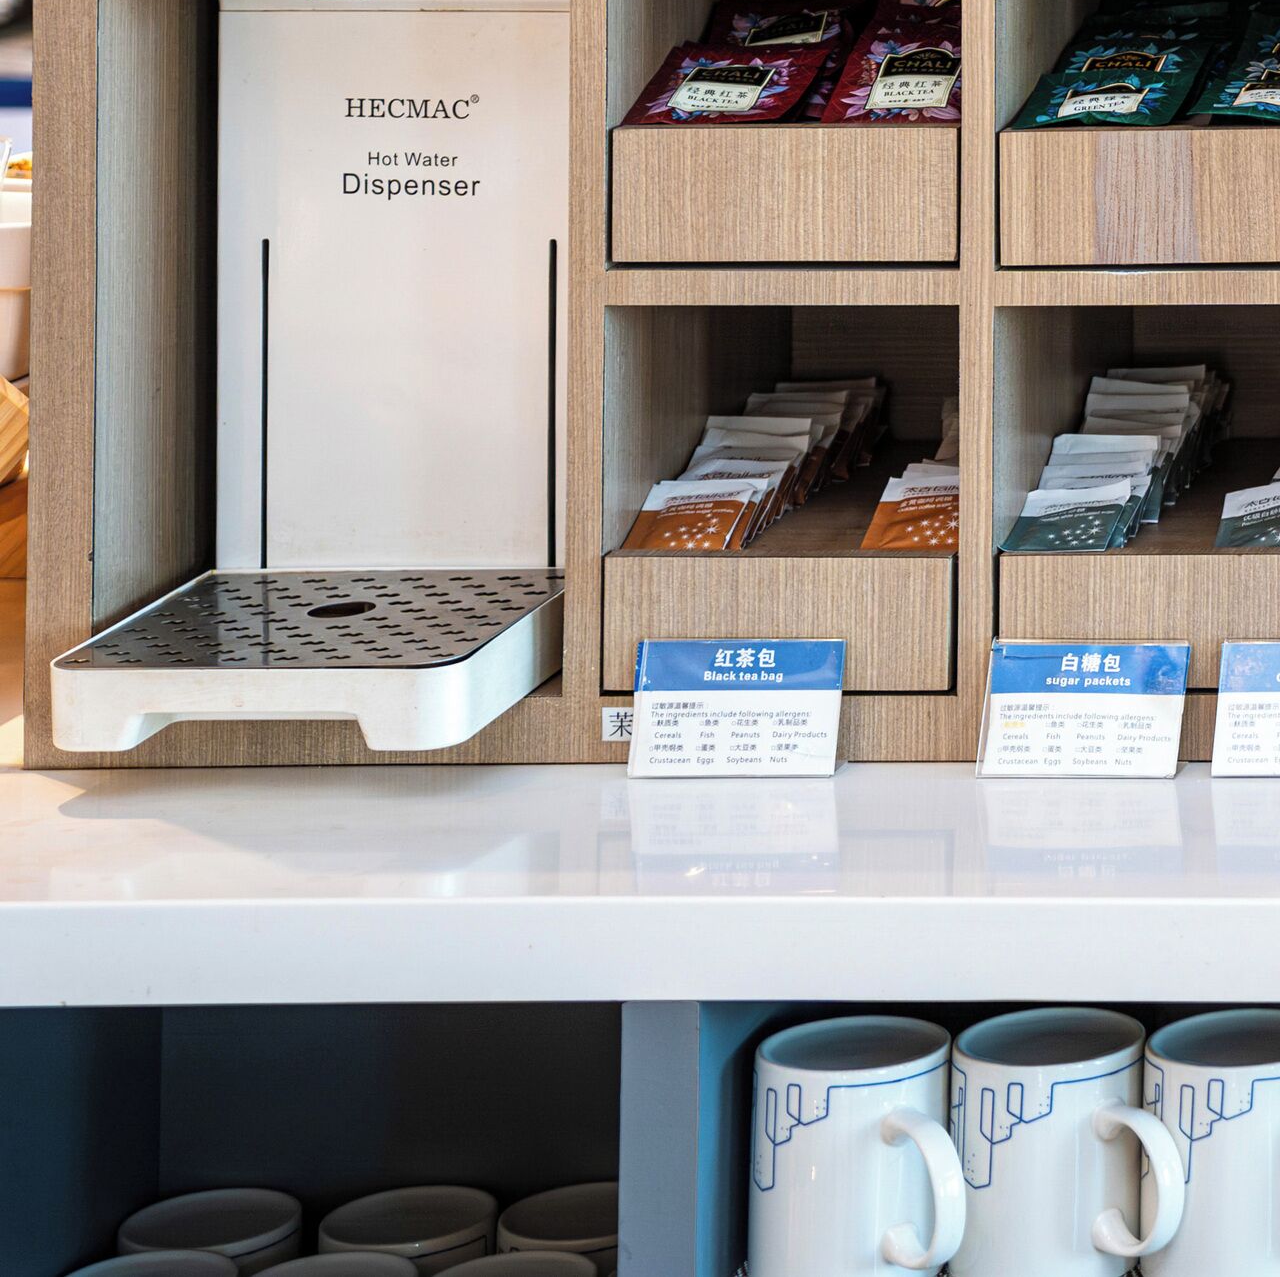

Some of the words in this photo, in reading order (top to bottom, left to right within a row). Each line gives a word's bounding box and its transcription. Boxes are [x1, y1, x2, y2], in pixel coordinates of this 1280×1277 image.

[894, 60, 952, 68] CHALI
[688, 95, 718, 103] BLACK
[368, 152, 398, 166] Hot
[405, 152, 458, 167] Water
[342, 173, 480, 201] Dispenser
[714, 648, 776, 668] 红茶包
[1060, 653, 1121, 673] 白糖包
[704, 671, 736, 682] Black
[738, 671, 758, 682] tea
[761, 671, 784, 683] bag
[1046, 676, 1080, 687] sugar
[1084, 676, 1131, 687] packets
[651, 711, 664, 719] The
[666, 711, 708, 719] ingredients
[709, 711, 738, 719] include
[738, 711, 774, 719] following
[654, 731, 682, 739] Cereals
[700, 731, 715, 739] Fish
[731, 731, 760, 739] Peanuts
[772, 731, 792, 739] Dairy
[794, 731, 827, 739] Products
